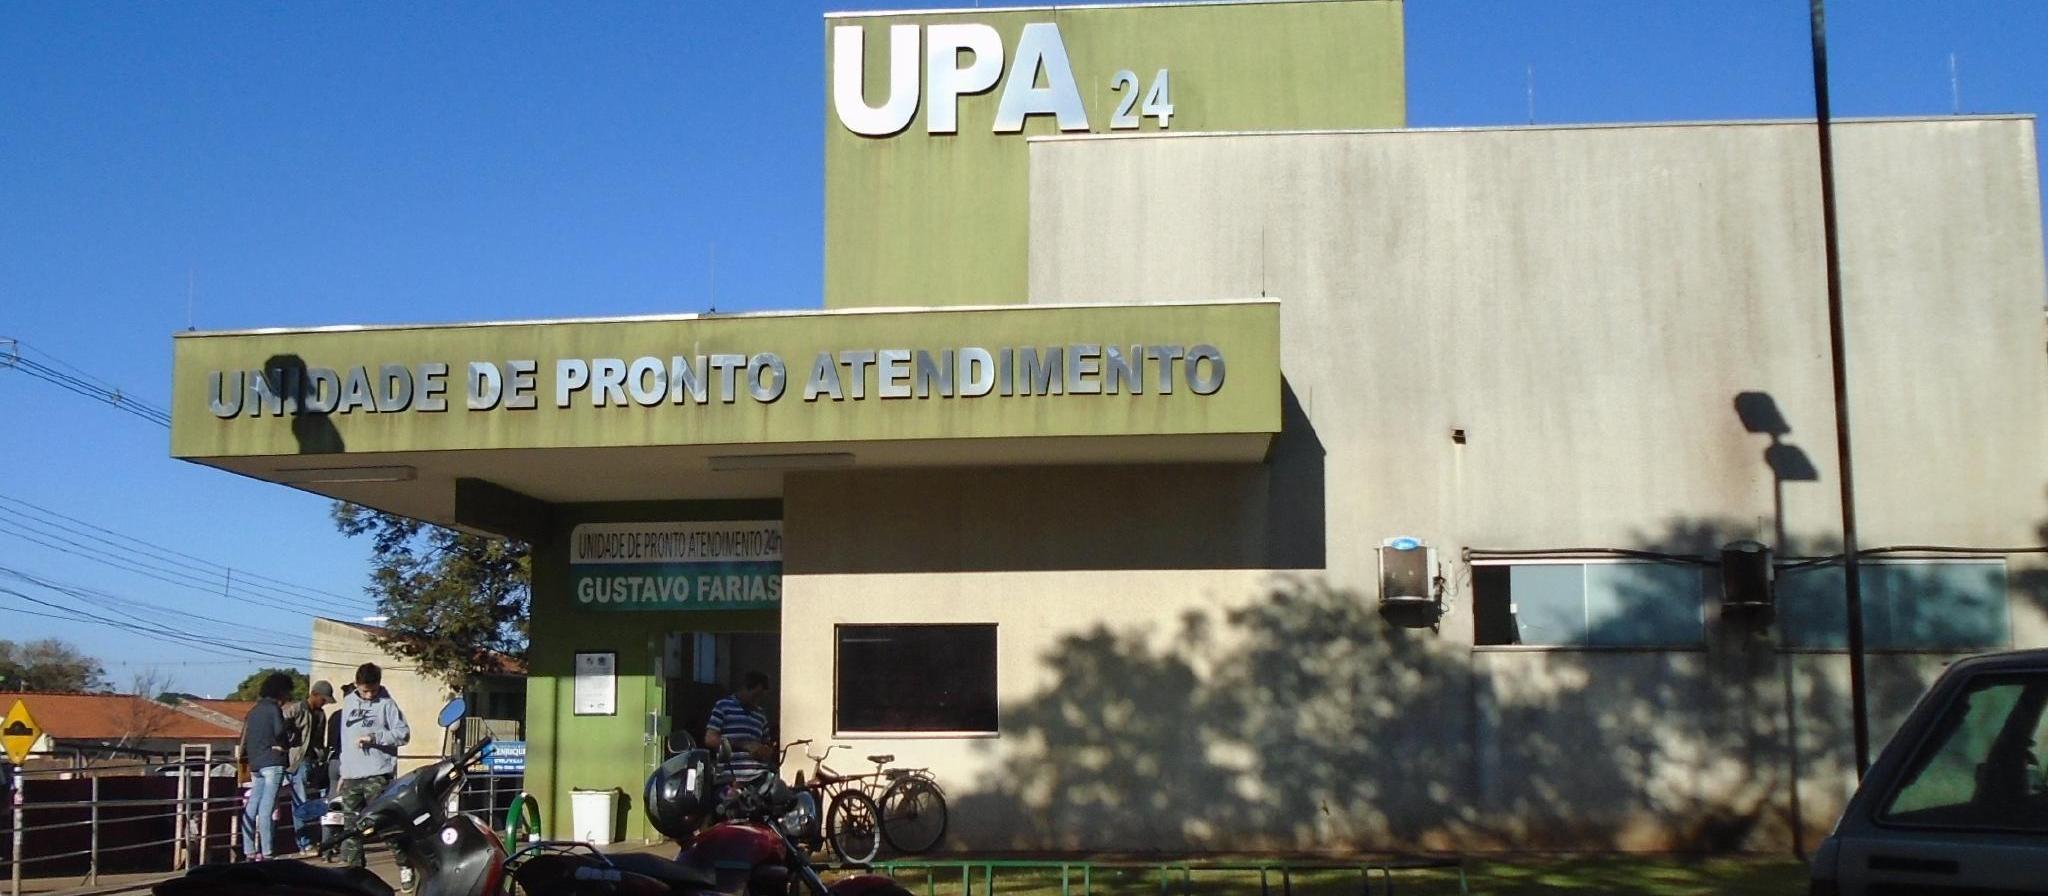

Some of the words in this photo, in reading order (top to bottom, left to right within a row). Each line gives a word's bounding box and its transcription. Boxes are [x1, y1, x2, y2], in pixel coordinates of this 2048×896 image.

[833, 22, 1090, 136] UPA
[1110, 68, 1175, 129] 24
[208, 362, 449, 419] UNIDADE
[467, 359, 538, 411] DE
[556, 352, 787, 409] PRONTO
[803, 343, 1226, 401] ATENDIMENTO
[578, 532, 625, 560] UNIDADE
[627, 532, 642, 559] DE
[644, 530, 685, 558] PRONTO
[688, 529, 762, 558] ATENDIMENTO
[577, 576, 690, 604] GUSTAVO
[697, 574, 782, 602] FARIAS
